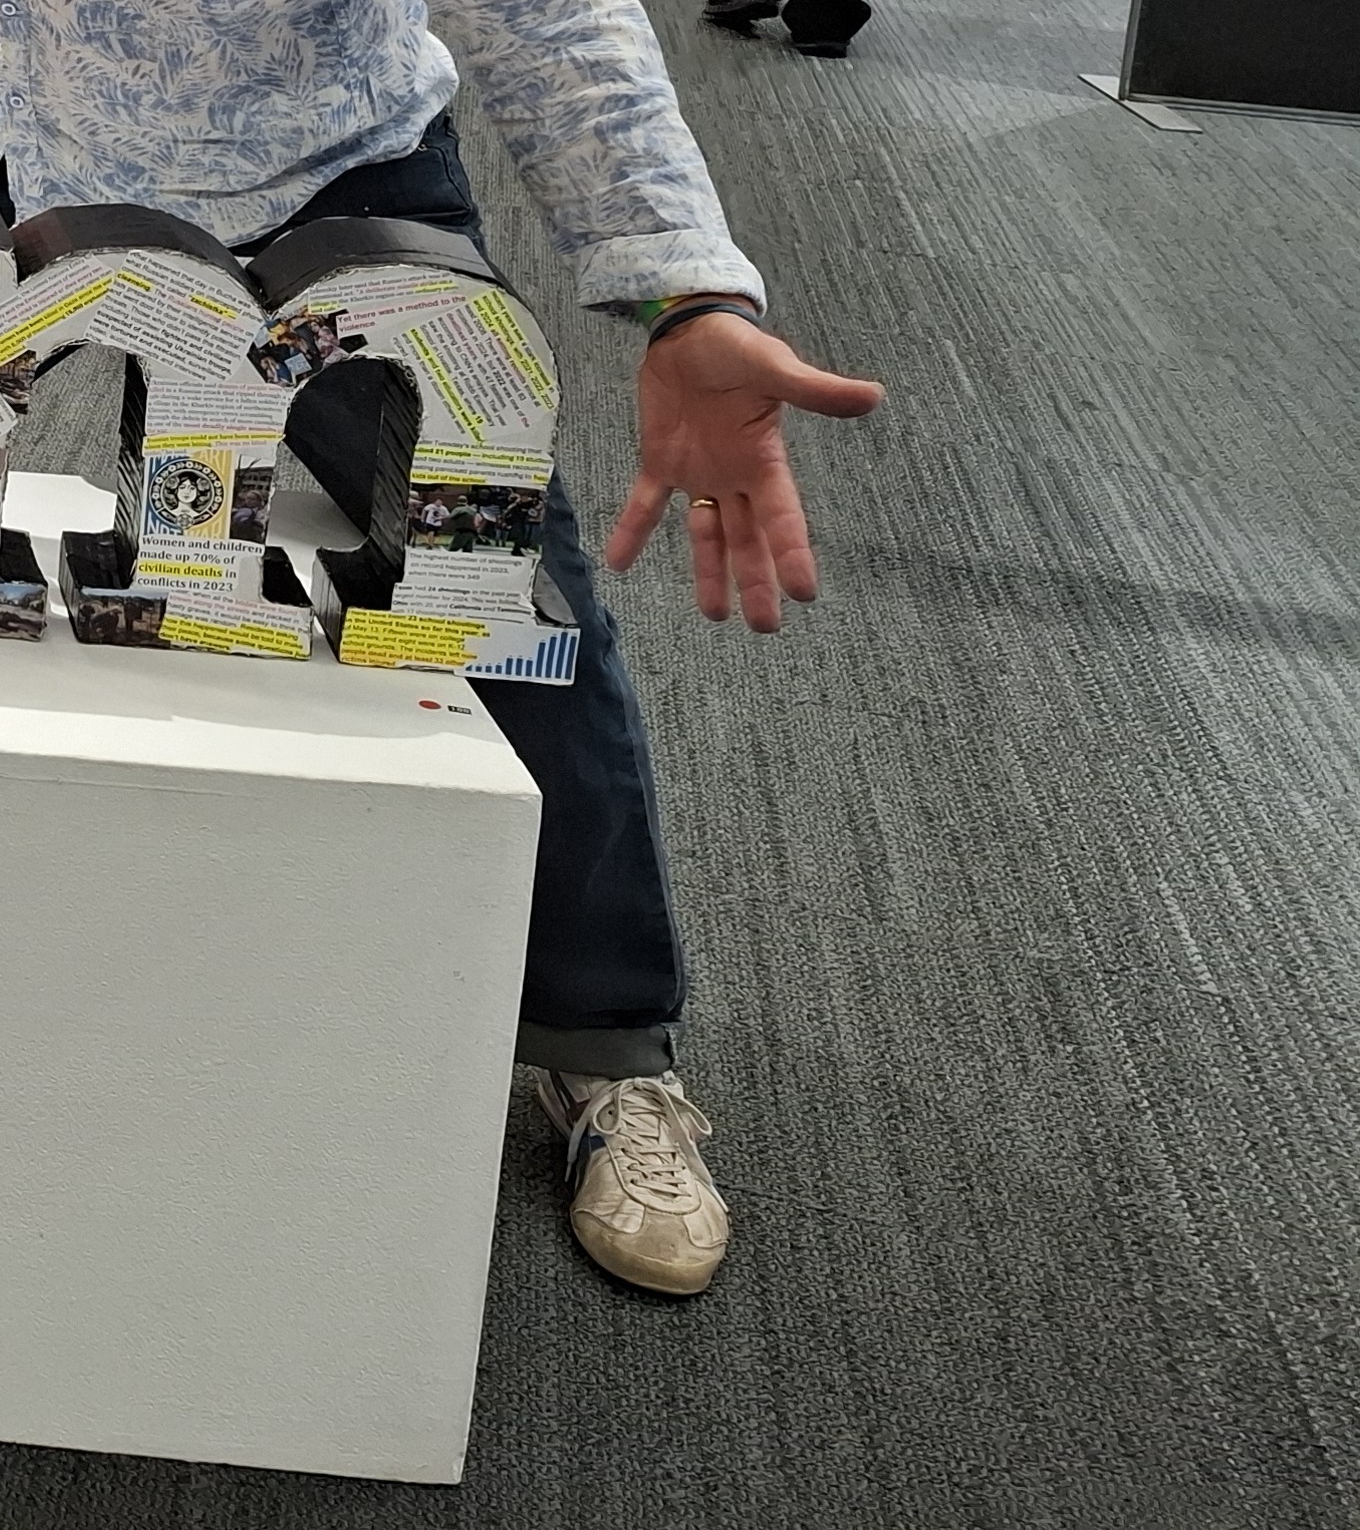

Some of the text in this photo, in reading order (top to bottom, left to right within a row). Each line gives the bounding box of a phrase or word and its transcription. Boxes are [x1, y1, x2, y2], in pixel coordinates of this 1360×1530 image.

[354, 311, 376, 321] there
[379, 308, 396, 316] was
[405, 300, 439, 311] method
[452, 295, 466, 303] the
[339, 321, 376, 333] violence
[142, 537, 263, 554] Women and children
[140, 550, 236, 564] made up 70% of
[138, 563, 237, 578] civilian deaths in
[137, 577, 233, 592] conflicts in 2023
